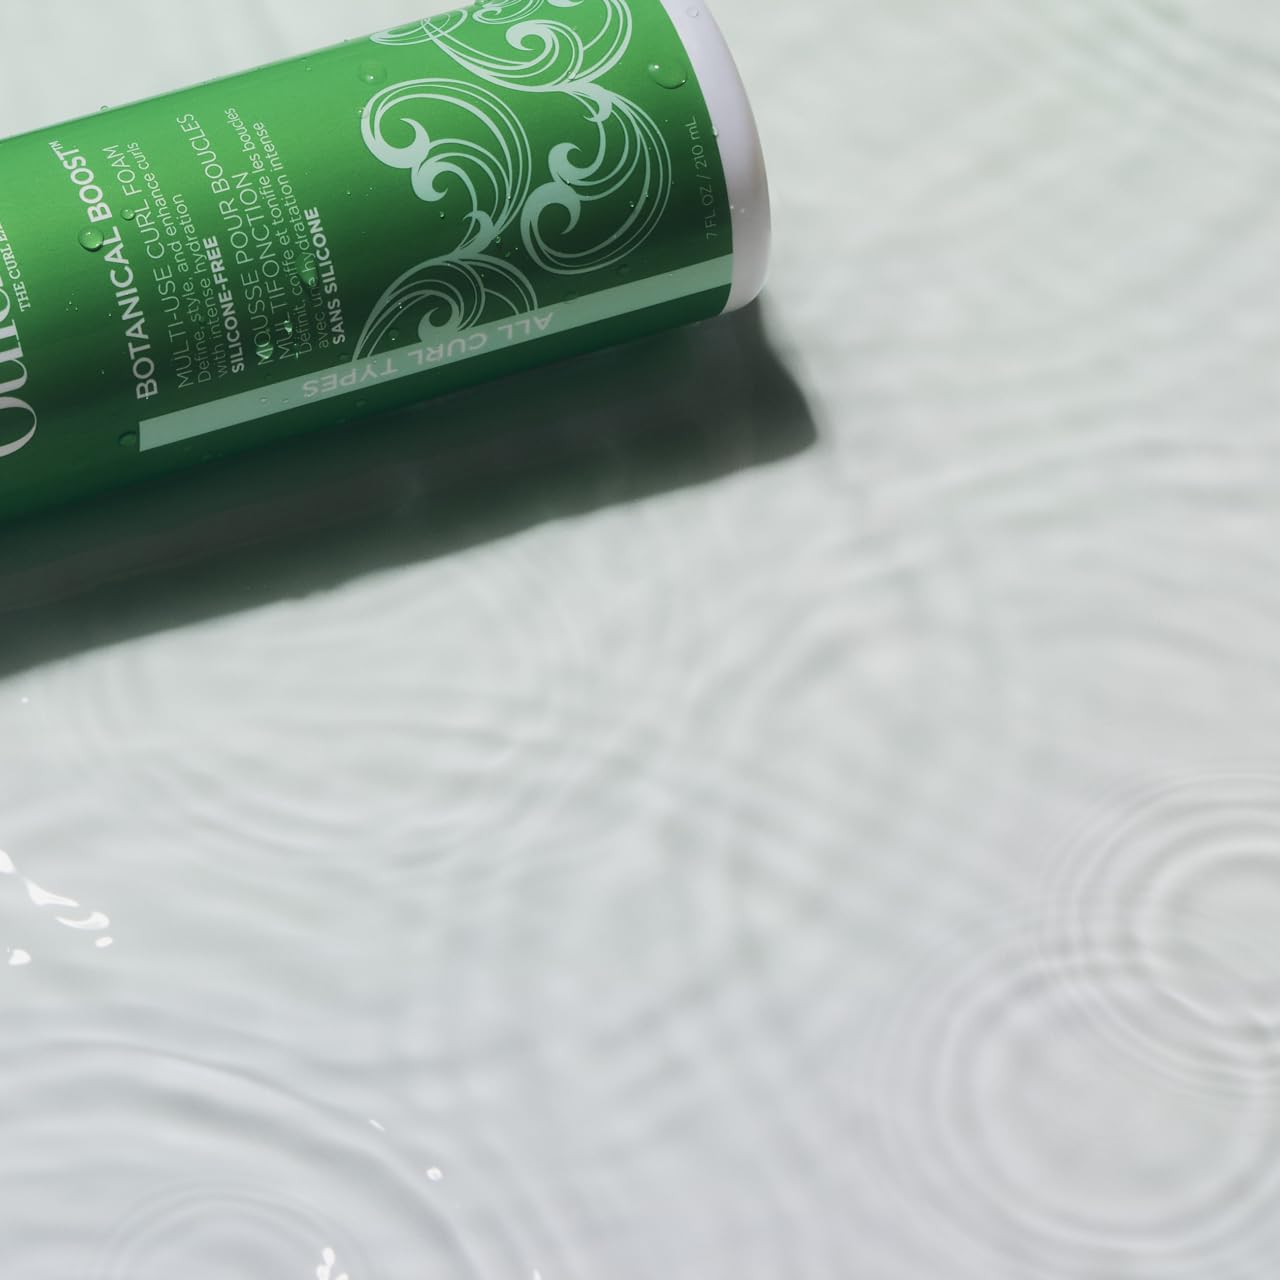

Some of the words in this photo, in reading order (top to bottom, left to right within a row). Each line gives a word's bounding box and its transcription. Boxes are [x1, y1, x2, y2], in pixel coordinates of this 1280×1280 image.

[224, 107, 256, 152] boucles
[252, 121, 284, 172] intense
[685, 114, 701, 141] mL
[102, 144, 142, 196] FOAM
[126, 142, 150, 170] curls
[176, 113, 230, 194] BOUCLES
[249, 152, 265, 174] les
[691, 144, 708, 169] 210
[144, 172, 177, 236] enhance
[258, 175, 284, 226] tonifie
[700, 184, 714, 207] OZ
[134, 198, 165, 259] CURL
[172, 193, 208, 274] hydration
[218, 198, 254, 264] POUR
[275, 227, 290, 246] et
[277, 174, 317, 273] hydratation
[704, 209, 717, 228] FL
[706, 232, 718, 240] 7
[0, 243, 21, 280] CURL
[167, 240, 189, 273] and
[282, 249, 303, 296] coiffe
[303, 206, 338, 294] SILICONE
[12, 281, 32, 312] THE
[102, 225, 159, 400] BOTANICAL
[181, 277, 202, 322] style,
[200, 277, 222, 340] intense
[202, 235, 245, 373] SILICONE-FREE
[308, 277, 323, 308] une
[153, 264, 194, 389] MULTI-USE
[240, 270, 274, 365] MOUSSE
[314, 311, 329, 349] avec
[327, 298, 346, 345] SANS
[497, 311, 554, 341] ALL
[193, 326, 212, 383] Define,
[211, 343, 228, 378] with
[407, 332, 488, 365] CURL
[302, 358, 398, 398] TYPES
